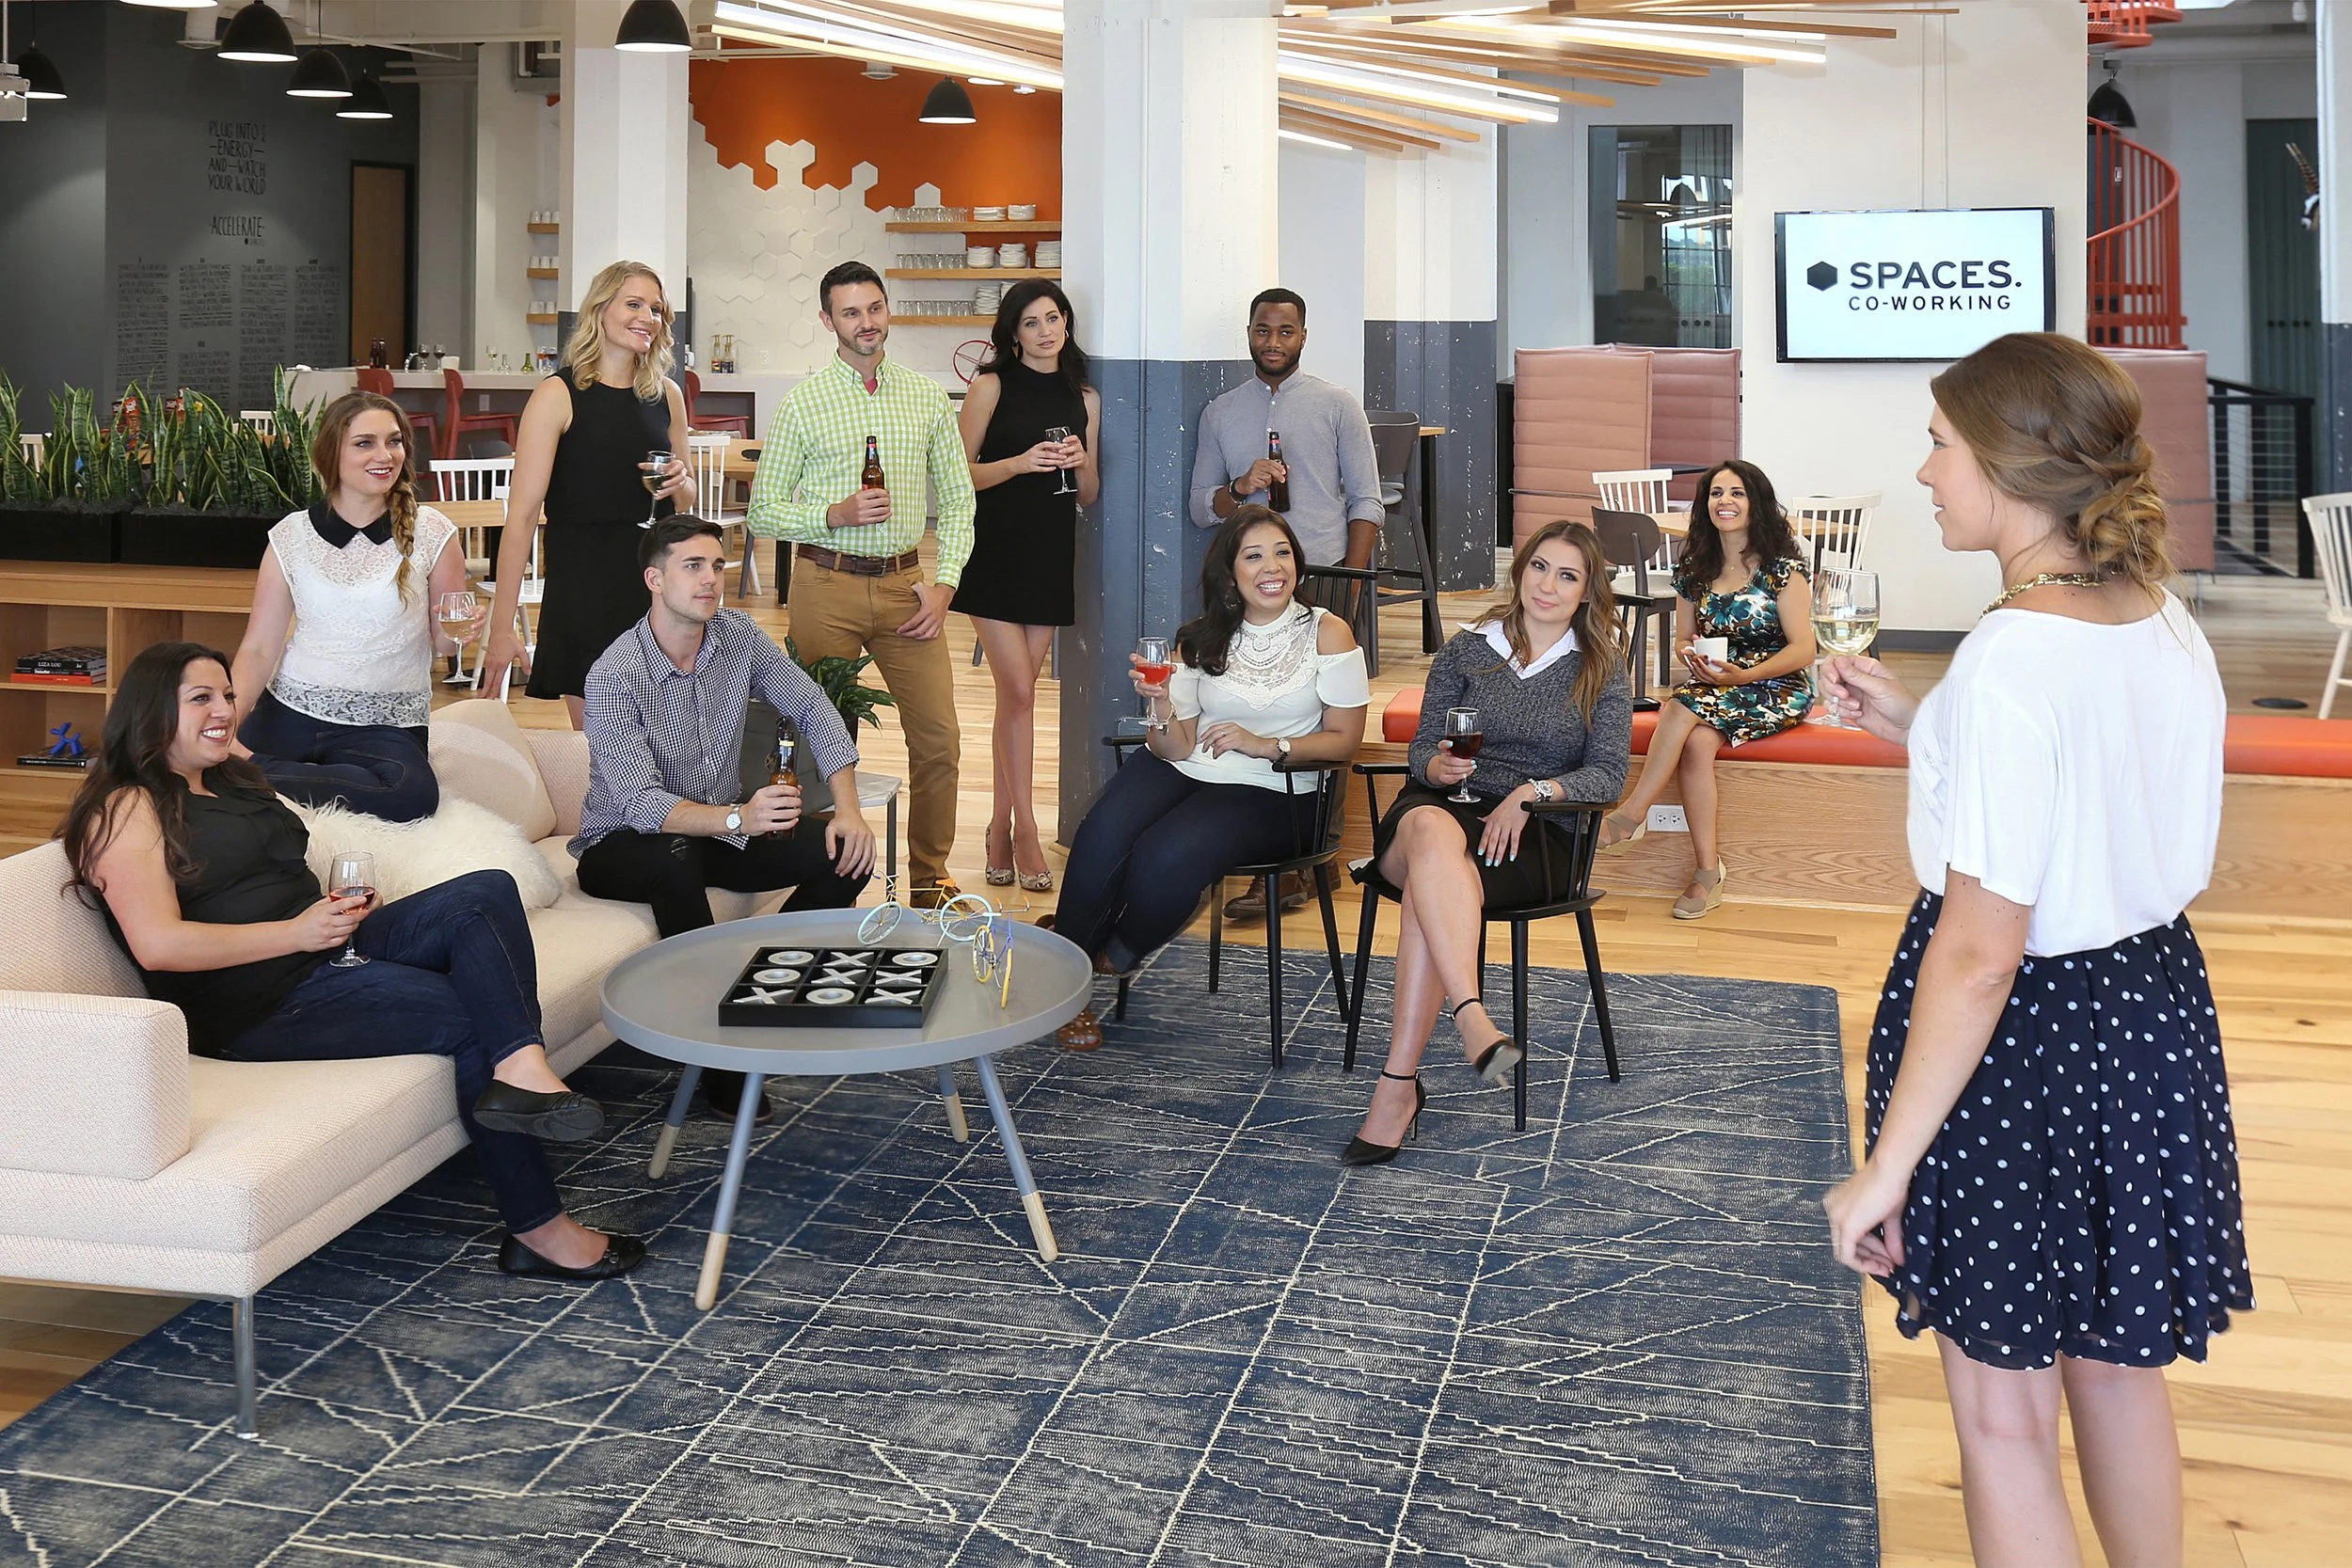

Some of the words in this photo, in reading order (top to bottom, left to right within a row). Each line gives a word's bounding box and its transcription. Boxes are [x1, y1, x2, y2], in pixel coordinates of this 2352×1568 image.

[208, 120, 233, 138] PLUG
[235, 122, 260, 140] INTO
[217, 138, 254, 158] ENERGY
[208, 157, 228, 172] AND
[237, 159, 266, 178] WATCH
[208, 174, 233, 192] YOUR
[235, 176, 266, 196] WORLD
[210, 215, 263, 237] ACCELERATE
[1850, 260, 2023, 290] SPACES.
[1849, 294, 2011, 311] CO-WORKING
